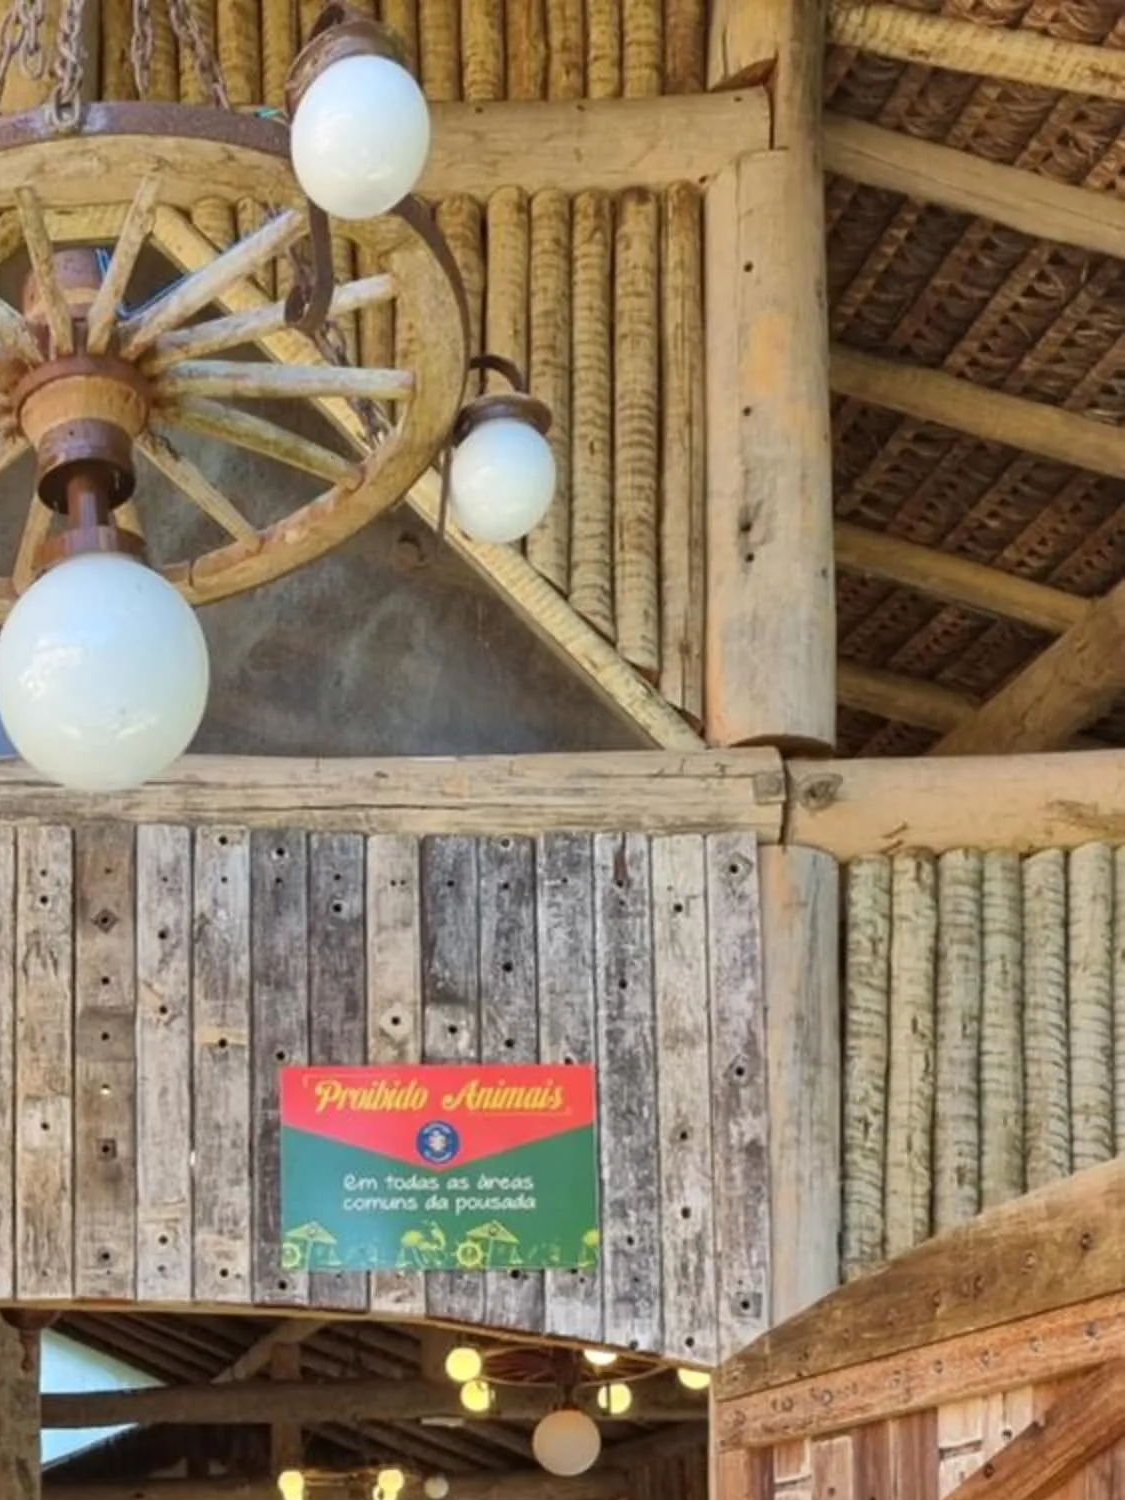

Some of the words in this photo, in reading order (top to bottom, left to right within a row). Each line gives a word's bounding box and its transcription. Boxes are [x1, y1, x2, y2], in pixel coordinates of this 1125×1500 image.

[315, 1079, 429, 1113] Proibido
[442, 1078, 564, 1111] Animais
[384, 1173, 440, 1190] todas
[446, 1176, 470, 1190] as
[342, 1197, 418, 1211] comuns
[424, 1194, 449, 1211] da
[455, 1195, 537, 1216] pousada
